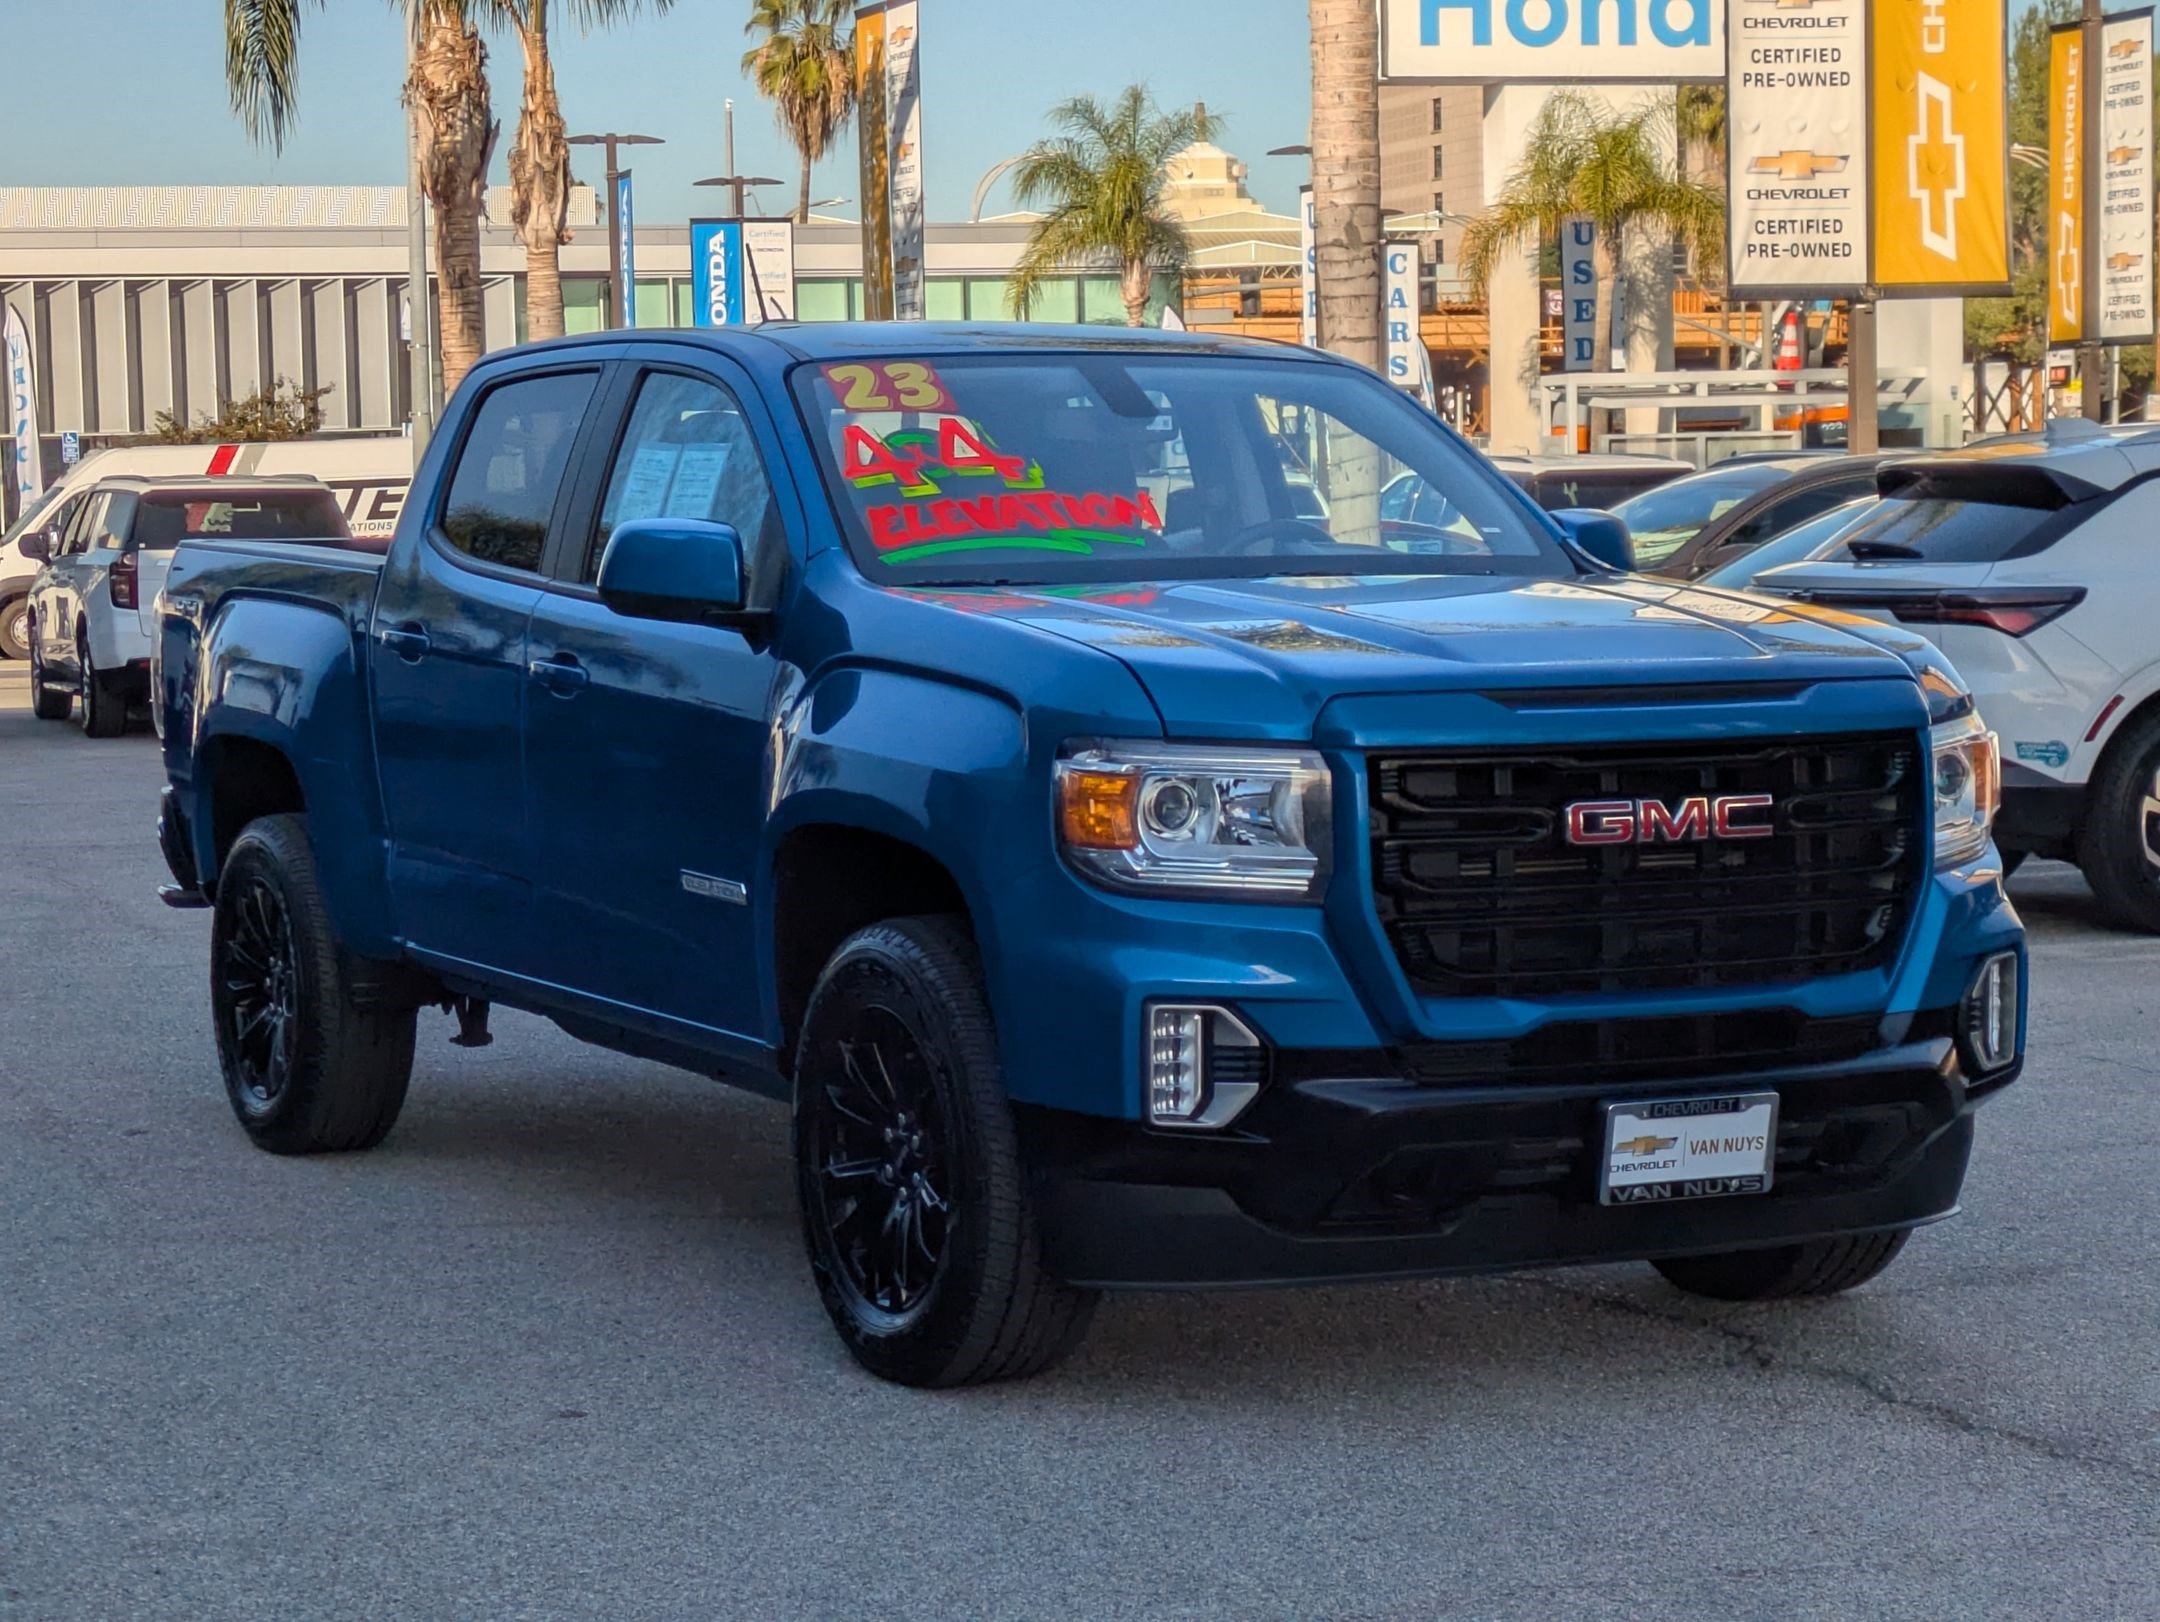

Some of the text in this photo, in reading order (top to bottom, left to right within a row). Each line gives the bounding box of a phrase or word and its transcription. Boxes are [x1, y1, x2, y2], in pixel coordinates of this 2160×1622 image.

[1743, 16, 1849, 28] CHEVROLET
[1751, 48, 1841, 63] CERTIFIED
[1743, 71, 1851, 87] PRE-OWNED
[2063, 44, 2079, 199] CHEVROLET
[1747, 189, 1850, 199] CHEVROLET
[1755, 219, 1843, 234] CERTIFIED
[1747, 243, 1852, 258] PRE-OWNED
[1573, 221, 1595, 361] USED
[1389, 253, 1410, 377] CARS
[829, 363, 942, 410] 23
[867, 491, 1164, 549] ELEVATION
[1566, 794, 1773, 844] GMC
[1654, 1100, 1736, 1117] CHEVROLET
[1690, 1136, 1765, 1155] VAN NUYS
[1610, 1159, 1677, 1173] CHEVROLET
[1613, 1176, 1762, 1202] VAN NUYS
